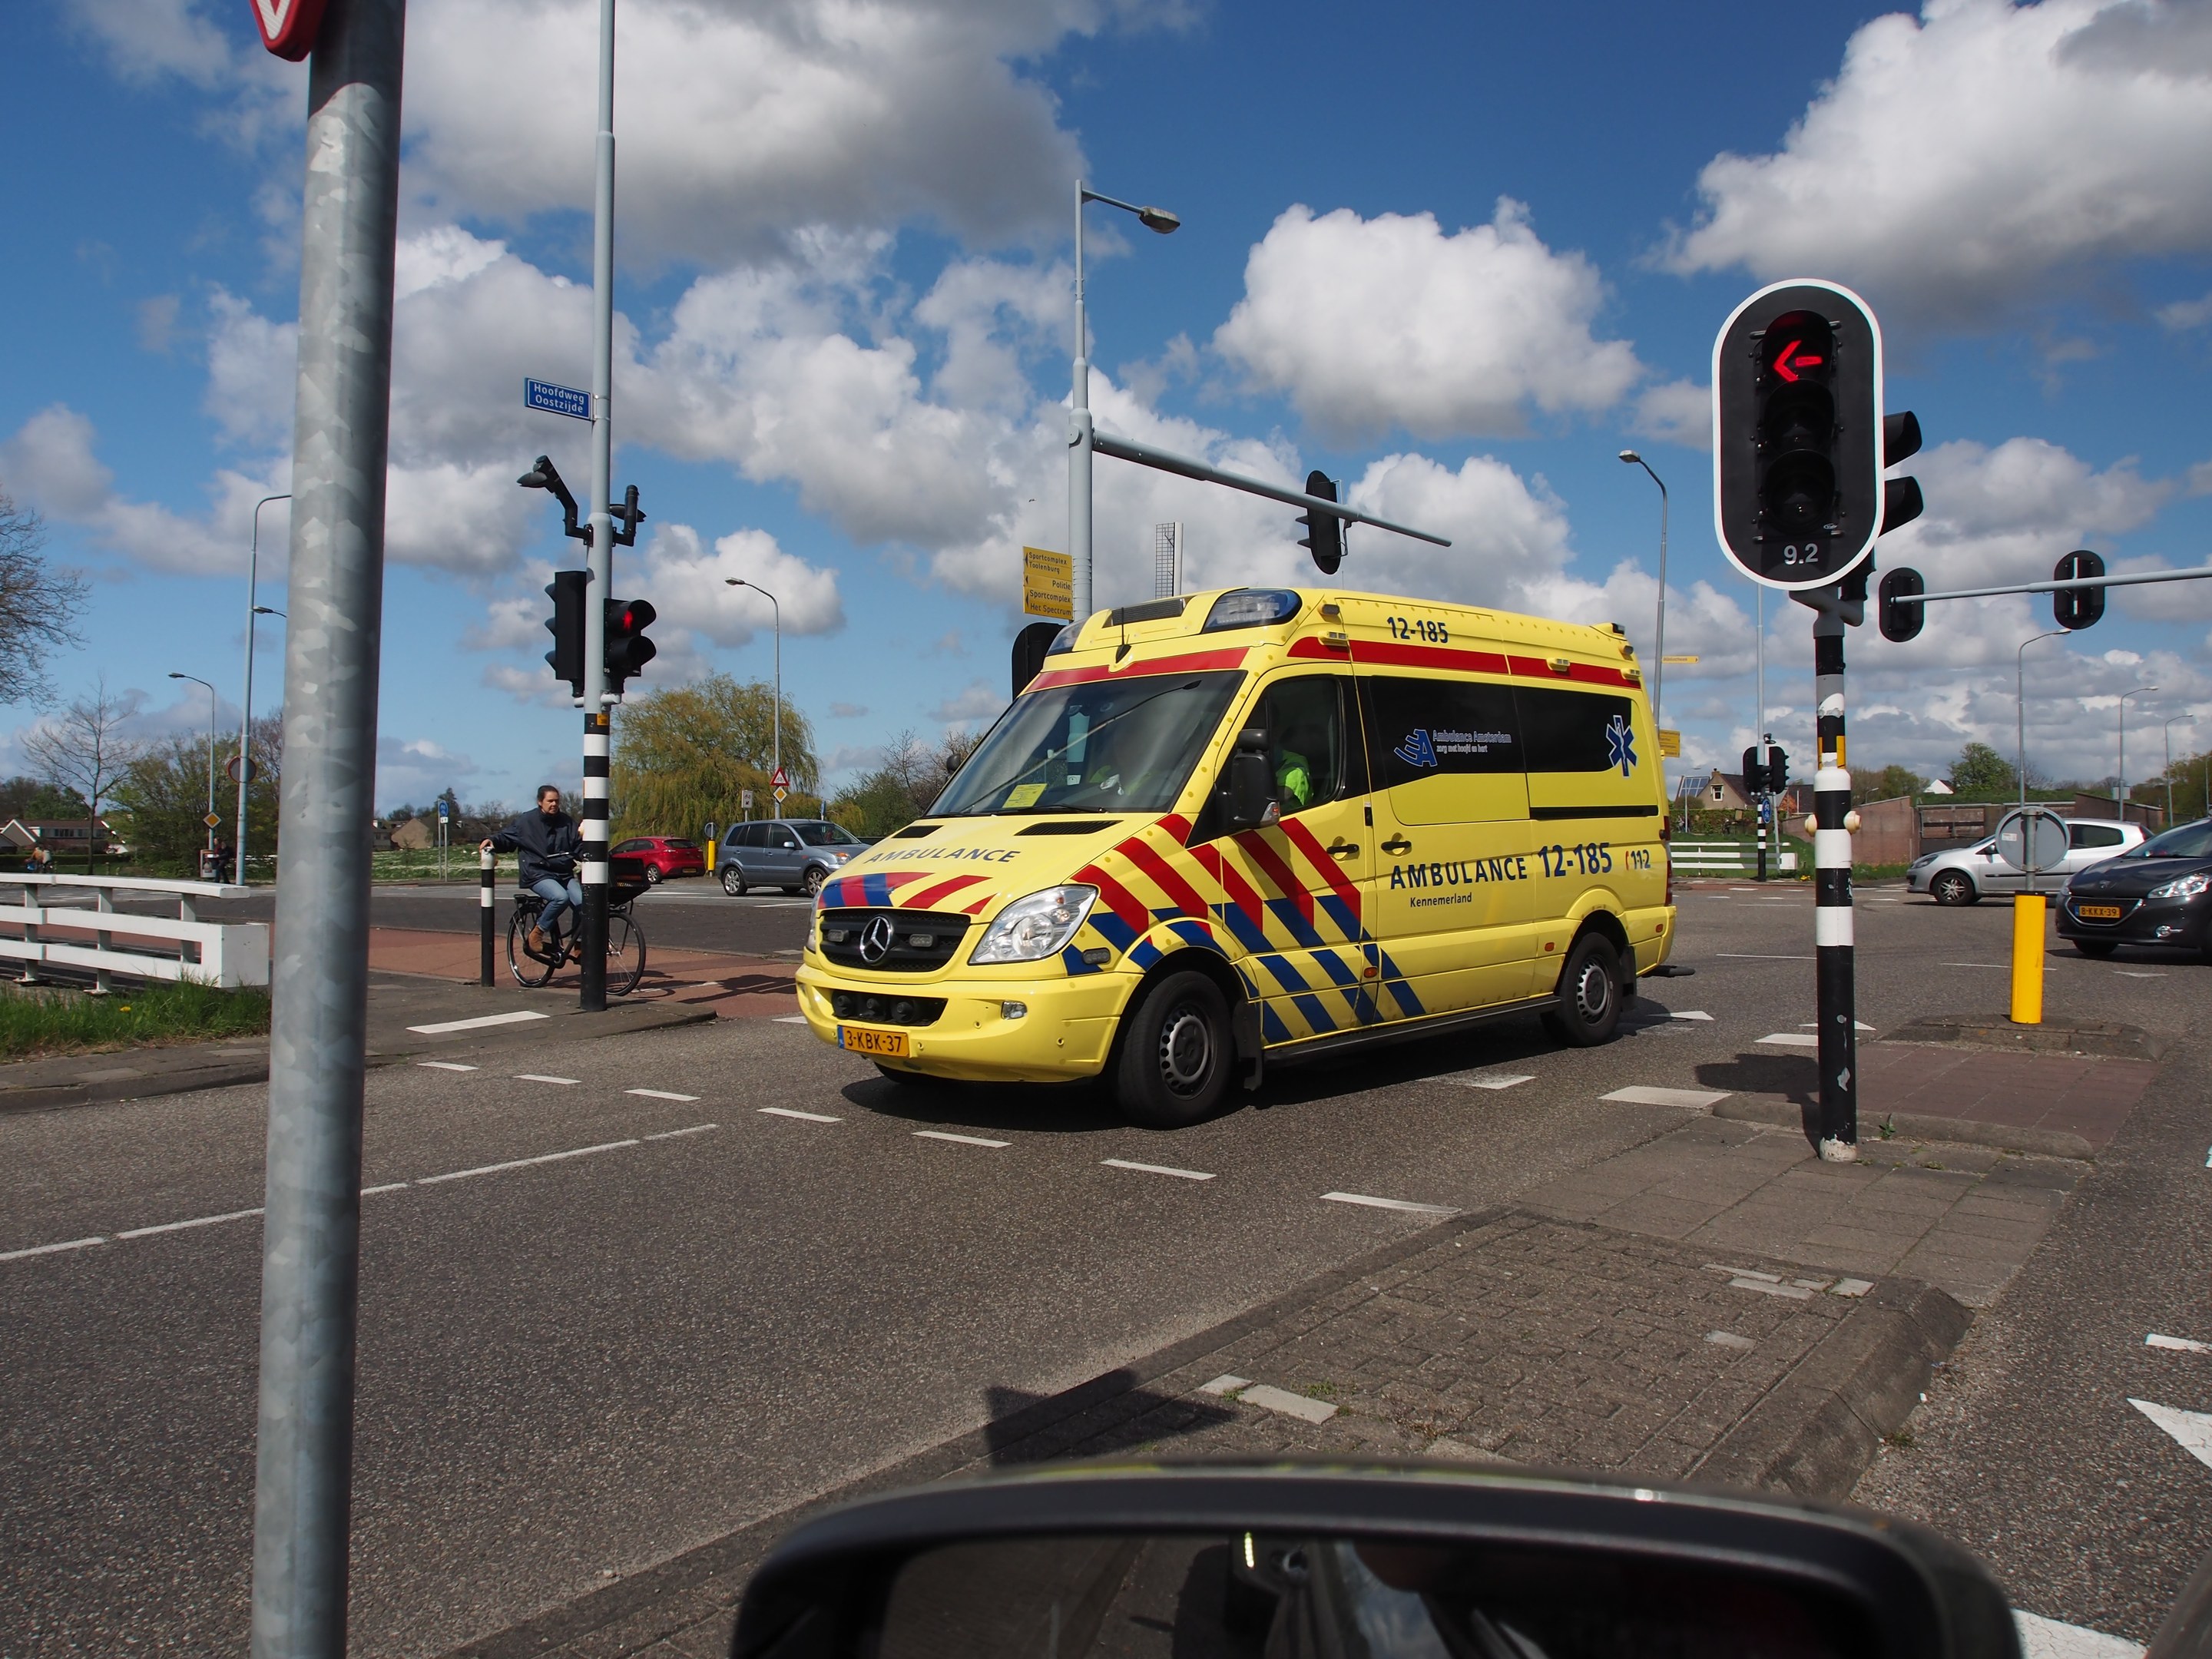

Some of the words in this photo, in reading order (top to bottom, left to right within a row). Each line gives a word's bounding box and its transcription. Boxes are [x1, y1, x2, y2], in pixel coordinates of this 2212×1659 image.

[534, 382, 584, 405] Hoofdweg
[535, 394, 583, 412] Oostzijde
[1028, 551, 1068, 565] Sportcomplex
[1783, 543, 1819, 565] 9.2
[1029, 561, 1061, 575] Toolenburg
[1051, 580, 1071, 591] Politie
[1029, 589, 1071, 603] Sportcomplex
[1030, 603, 1041, 611] Het
[1044, 605, 1071, 616] Spectrum
[1387, 616, 1449, 644] 12-185
[1432, 729, 1473, 743] Ambulance
[1473, 730, 1512, 743] Amsterdam
[863, 847, 1022, 865] AMBULANCE
[1390, 856, 1528, 890] AMBULANCE
[1538, 842, 1612, 878] 12-185
[1409, 892, 1472, 908] Kennemerland
[2081, 907, 2117, 916] 8-KKX-39
[846, 1030, 902, 1052] 3-KBK-37
